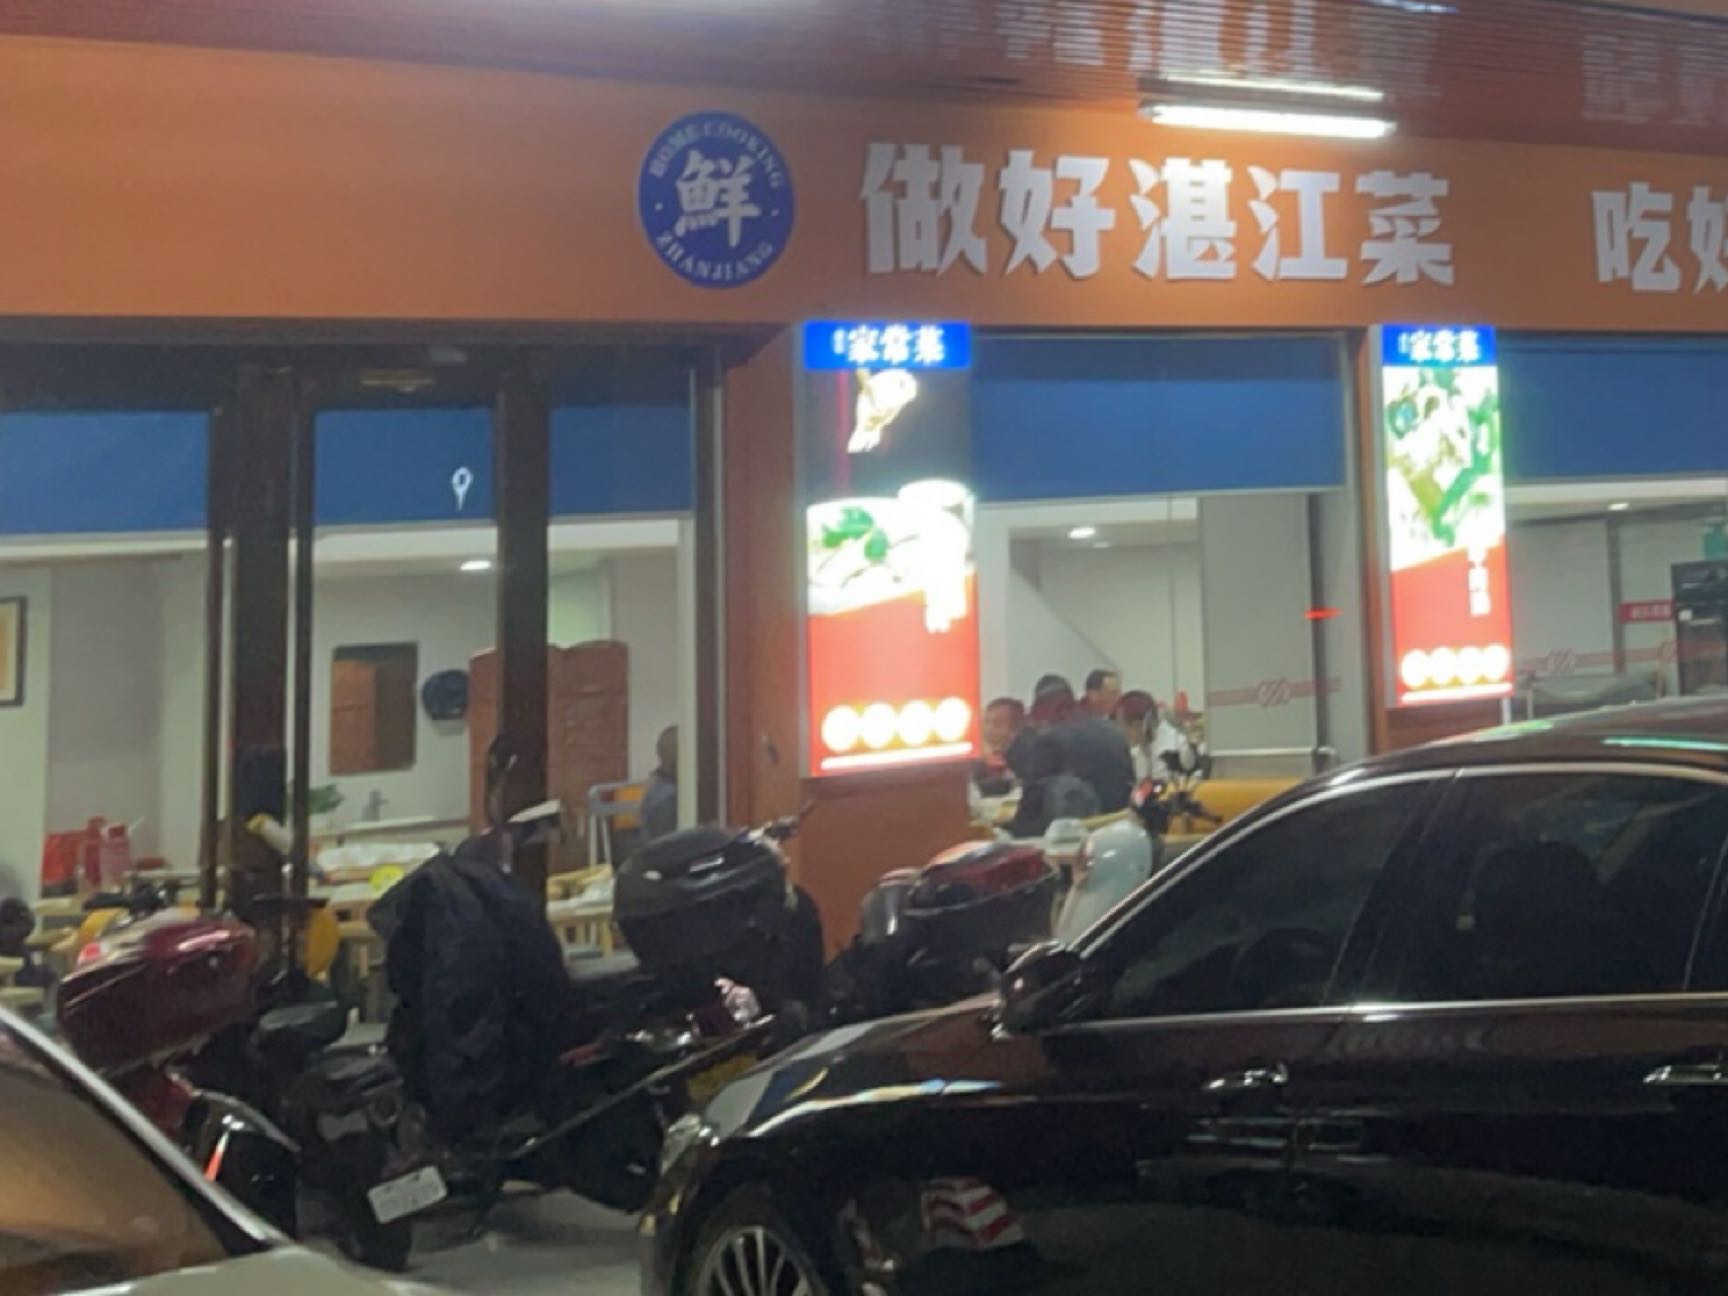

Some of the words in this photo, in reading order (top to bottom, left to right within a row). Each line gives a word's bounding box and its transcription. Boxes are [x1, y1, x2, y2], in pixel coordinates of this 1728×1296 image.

[648, 120, 699, 178] HOME
[701, 120, 784, 190] COOKING
[674, 148, 762, 249] 鲜
[860, 141, 1457, 290] 做好湛江菜
[655, 230, 774, 282] ZHANJIANG
